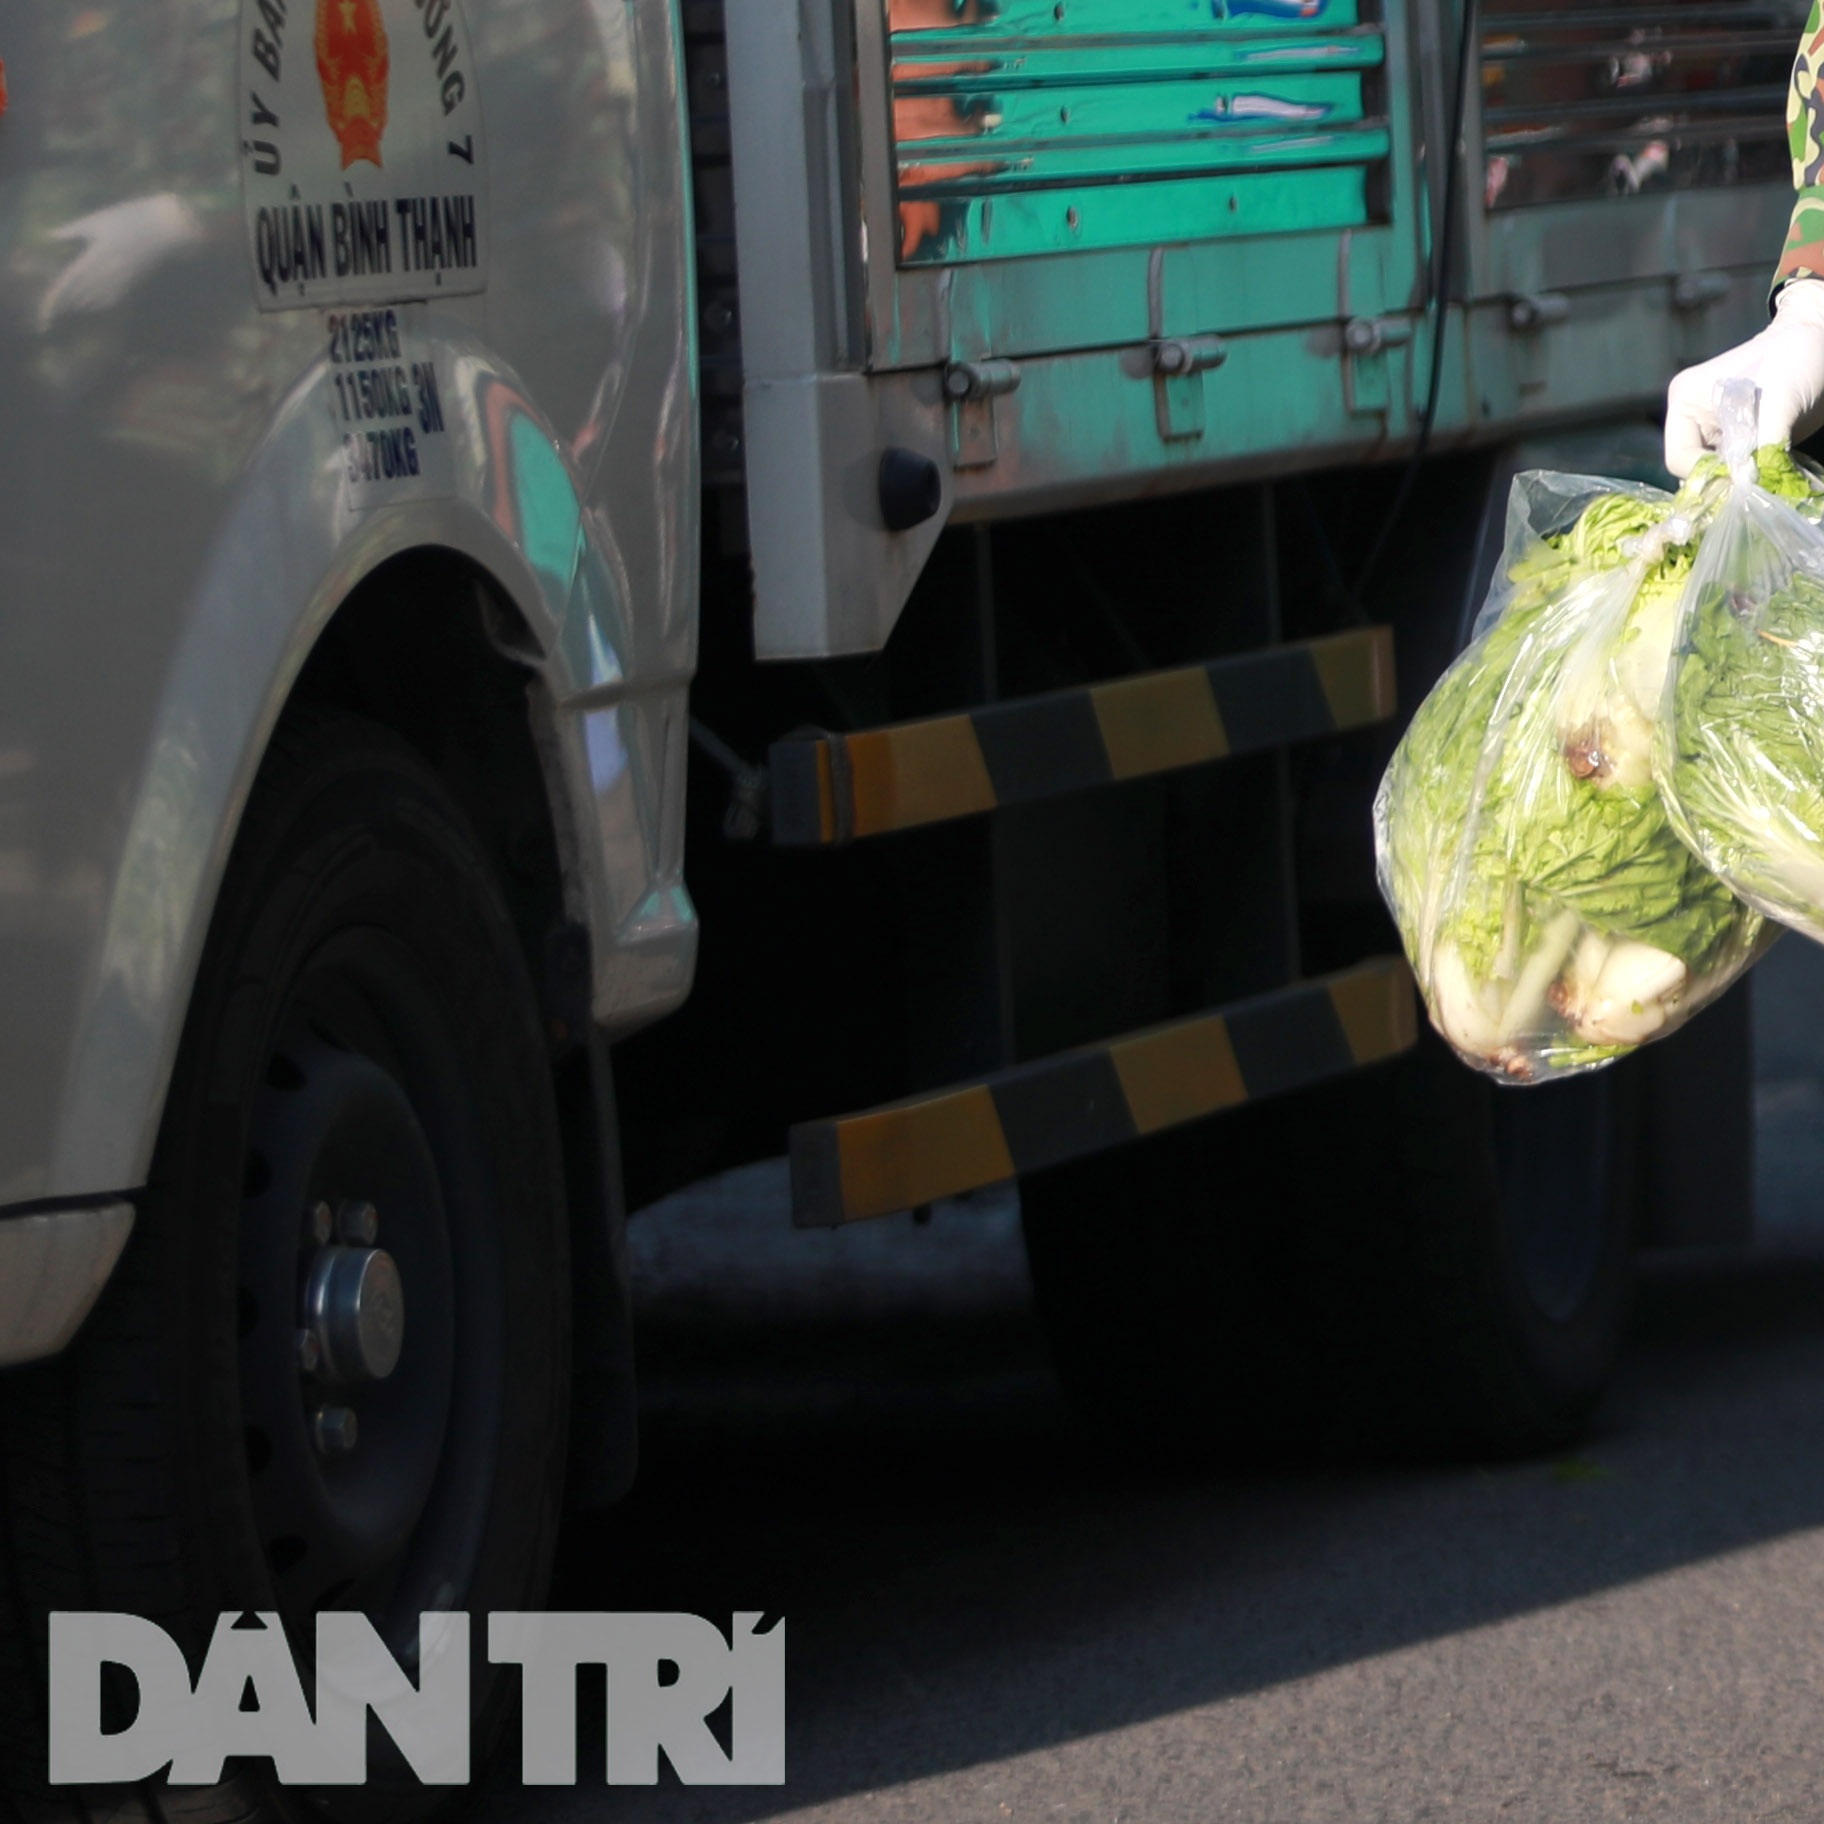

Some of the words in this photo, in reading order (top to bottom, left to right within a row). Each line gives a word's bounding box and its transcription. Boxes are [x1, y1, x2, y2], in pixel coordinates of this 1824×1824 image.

[447, 135, 475, 166] 7
[257, 183, 327, 297] QUẬN
[331, 182, 392, 277] BÌNH
[395, 195, 478, 286] THẠNH
